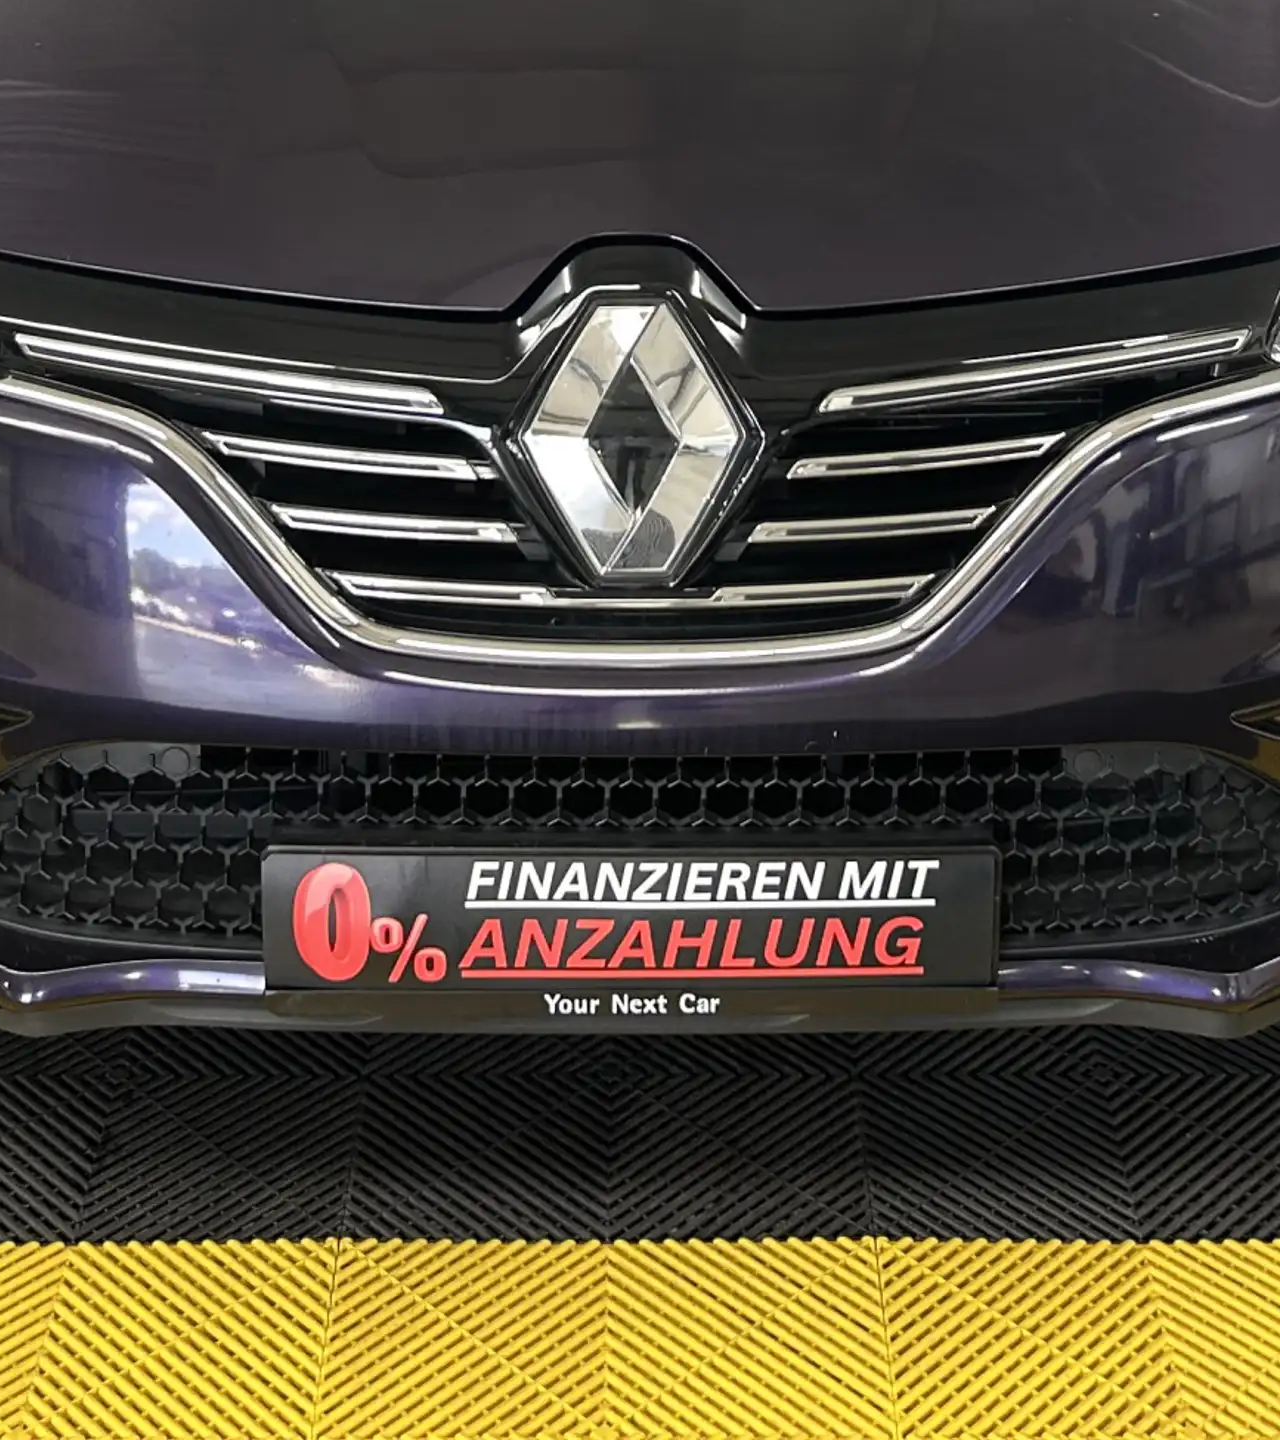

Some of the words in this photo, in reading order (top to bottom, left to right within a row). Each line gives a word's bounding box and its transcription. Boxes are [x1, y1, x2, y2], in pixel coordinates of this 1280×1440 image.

[465, 859, 826, 901] FINANZIEREN
[837, 858, 940, 901] MIT
[292, 861, 448, 983] 0%
[458, 914, 925, 968] ANZAHLUNG
[543, 992, 600, 1015] Your
[611, 992, 668, 1015] Next
[679, 992, 721, 1015] Car
